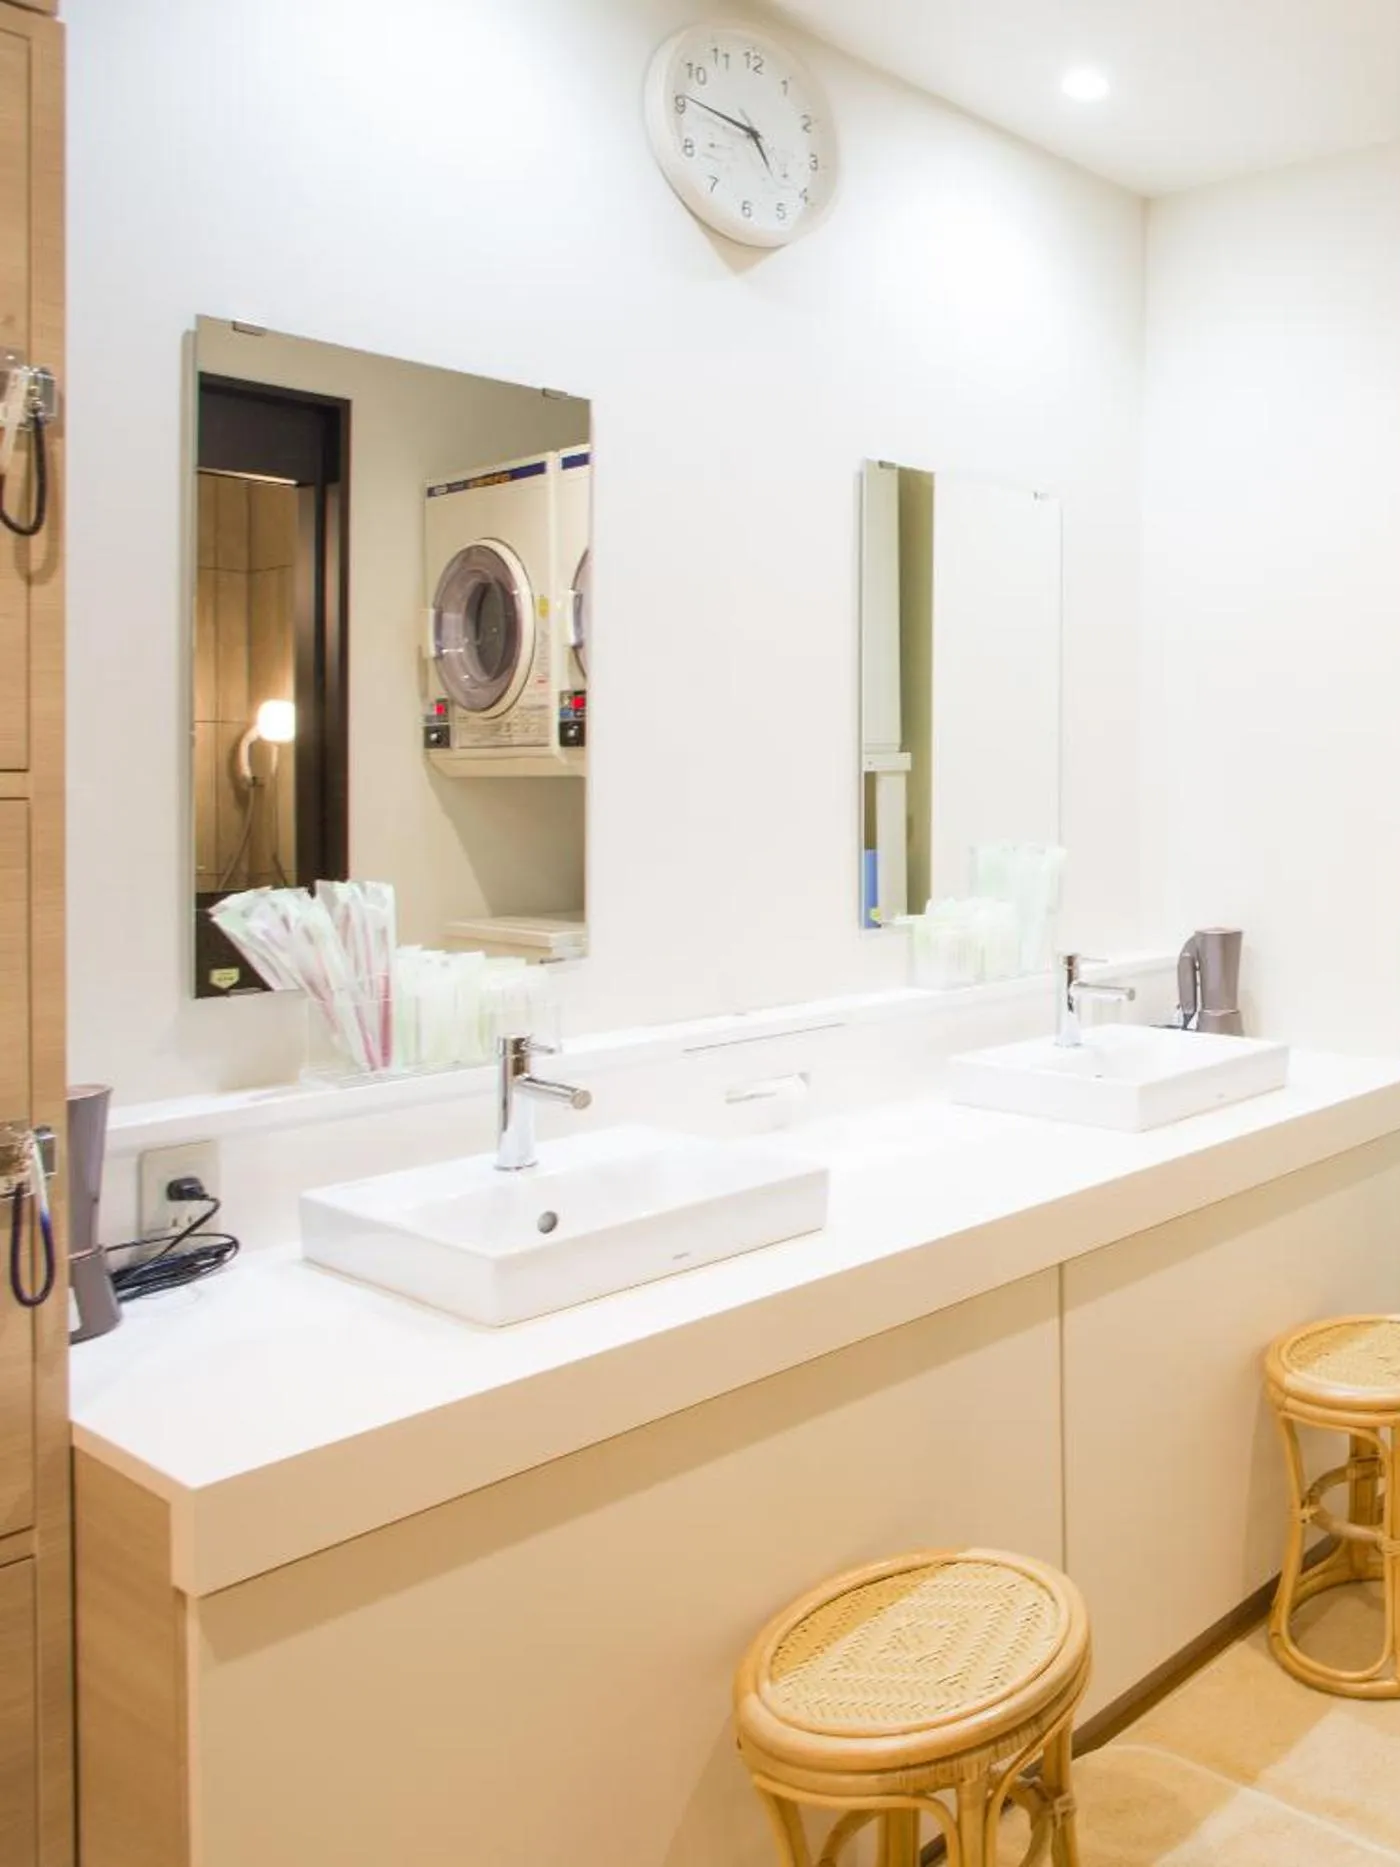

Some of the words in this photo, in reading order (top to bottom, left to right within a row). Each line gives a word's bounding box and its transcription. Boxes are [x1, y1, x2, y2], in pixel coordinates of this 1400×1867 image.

[712, 48, 730, 70] 11
[743, 50, 765, 75] 12
[686, 62, 707, 86] 10
[781, 80, 789, 96] 1
[674, 94, 687, 114] 9
[801, 114, 812, 133] 2
[683, 138, 695, 158] 8
[809, 153, 819, 171] 3
[708, 175, 719, 192] 7
[742, 201, 752, 218] 6
[776, 203, 787, 219] 5
